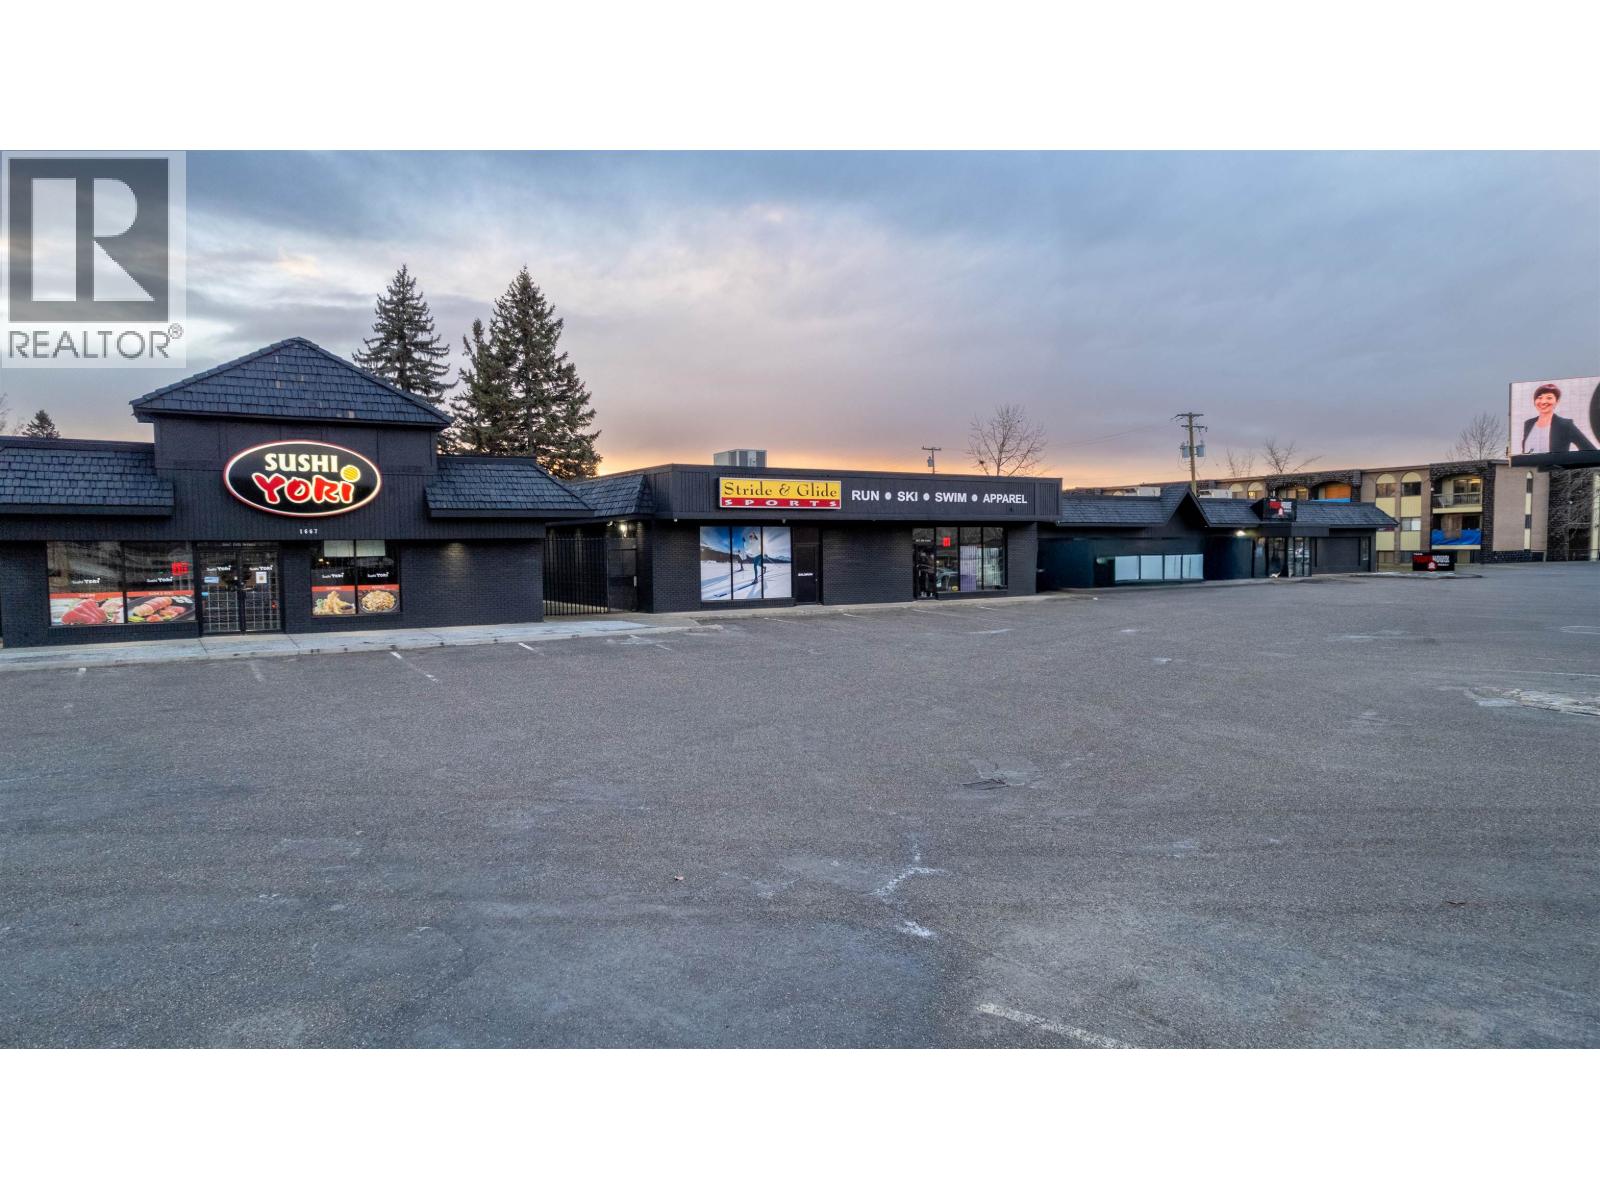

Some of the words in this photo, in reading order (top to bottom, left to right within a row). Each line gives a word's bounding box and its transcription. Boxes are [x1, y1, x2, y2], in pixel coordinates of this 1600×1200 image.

[264, 453, 339, 473] SUSHI
[724, 480, 773, 496] Stride
[779, 483, 791, 496] &
[796, 482, 838, 497] Glide
[724, 499, 838, 507] SPORTS
[851, 490, 880, 501] RUN
[897, 491, 918, 502] SKI
[935, 492, 967, 503] SWIM
[982, 494, 1028, 504] APPAREL
